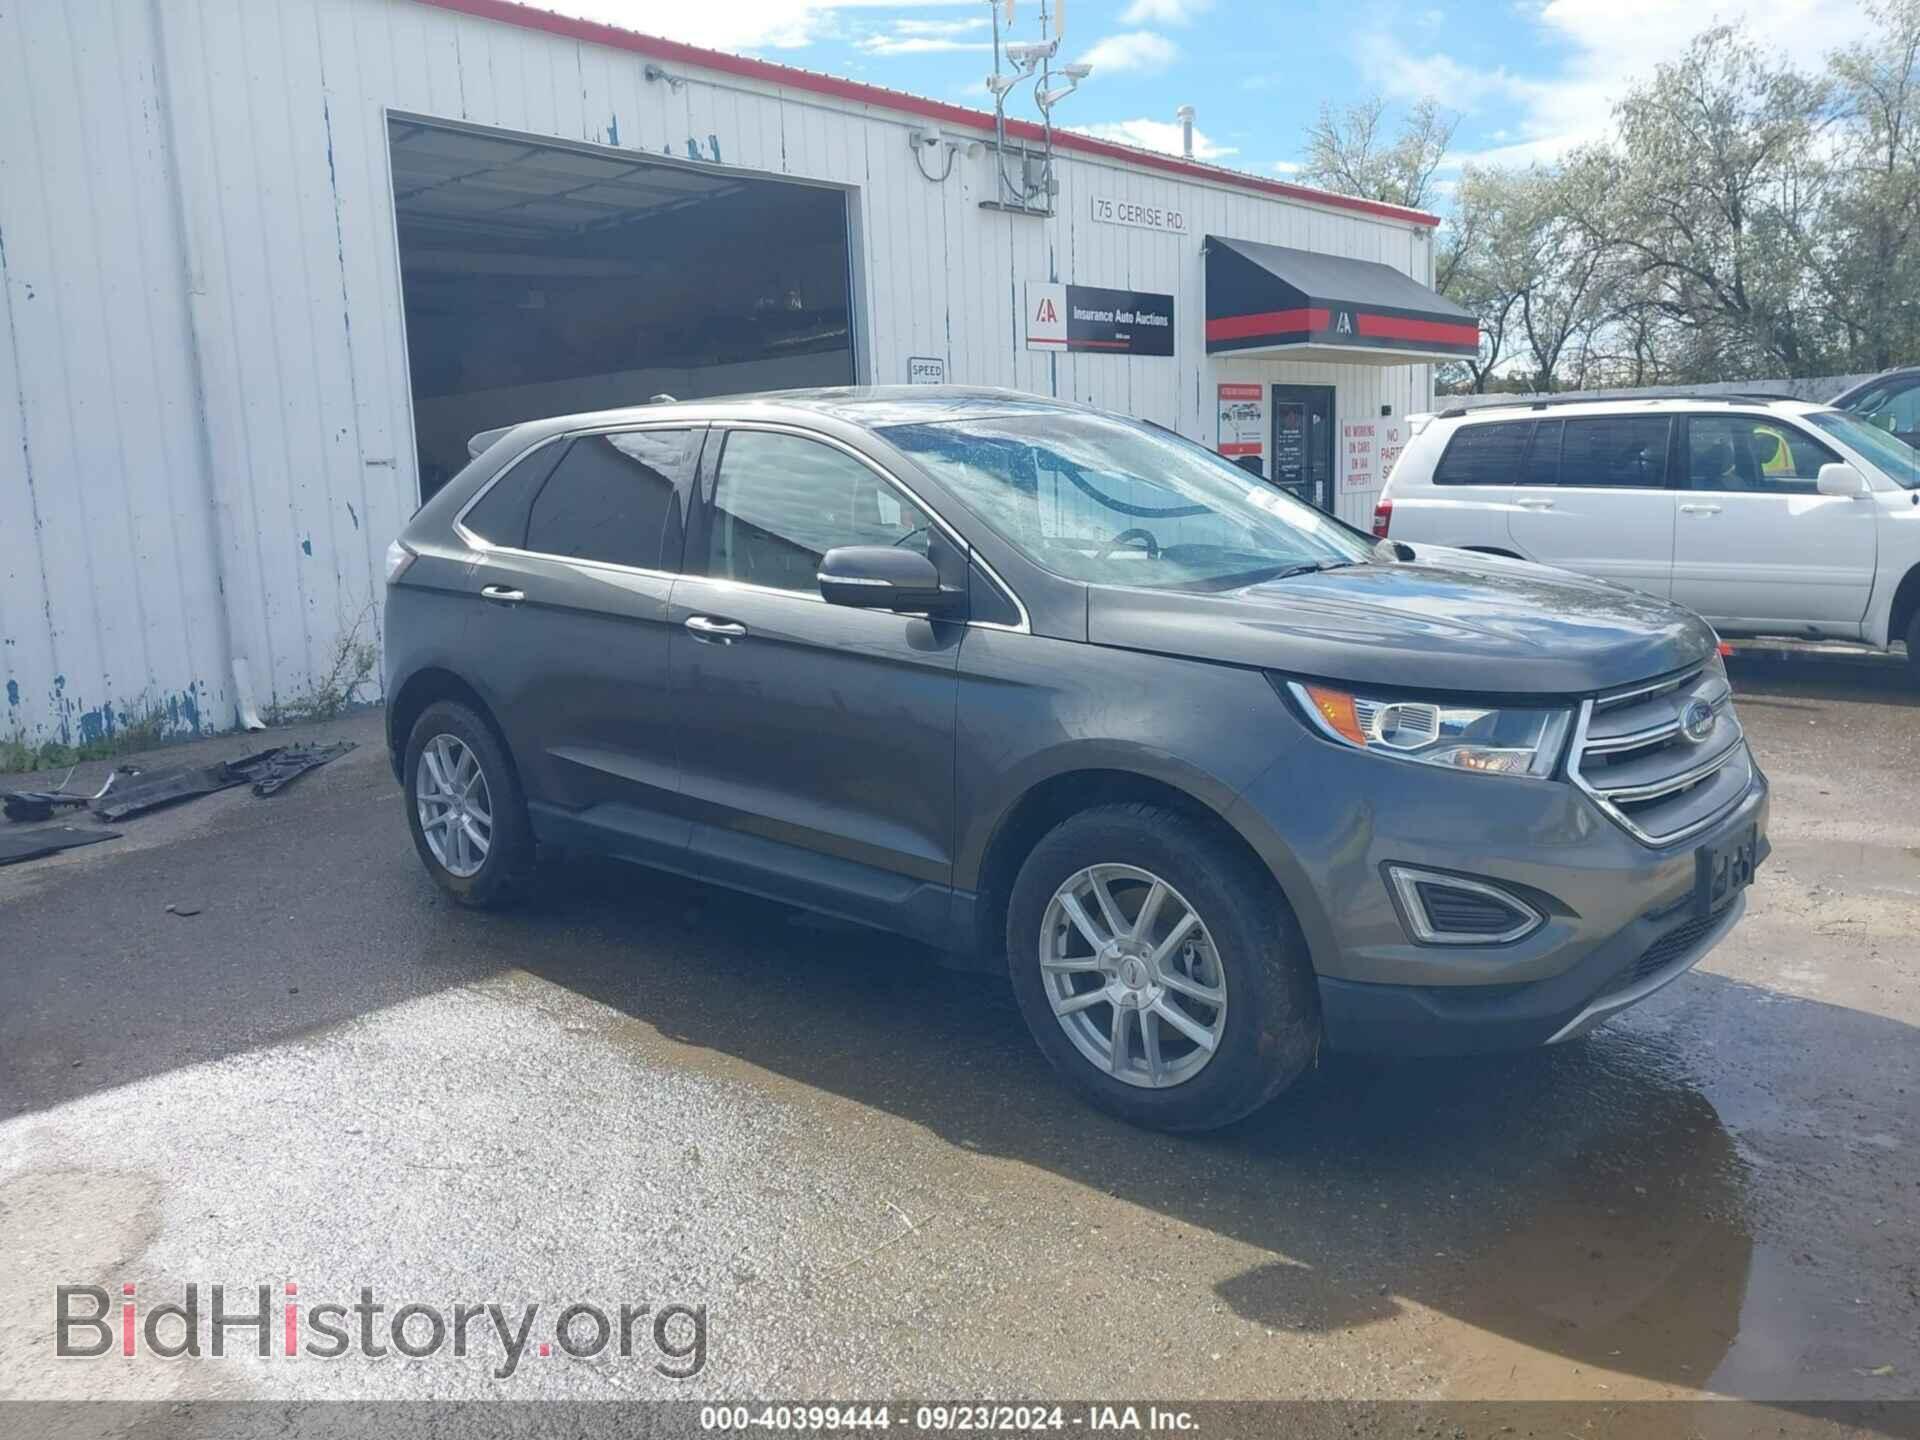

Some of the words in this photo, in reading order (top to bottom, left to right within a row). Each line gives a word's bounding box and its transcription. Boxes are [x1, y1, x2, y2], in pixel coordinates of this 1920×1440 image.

[1098, 200, 1113, 218] 75
[1118, 203, 1161, 226] CERISE
[1167, 212, 1186, 230] RD.
[1073, 305, 1113, 323] Insurance
[1115, 309, 1134, 324] Auto
[1135, 311, 1168, 327] Auctions
[913, 365, 941, 376] SPEED
[1344, 425, 1352, 437] NO
[1353, 425, 1375, 437] WORKING
[1387, 428, 1398, 442] NO
[1349, 442, 1356, 453] ON
[1357, 441, 1370, 453] CARS
